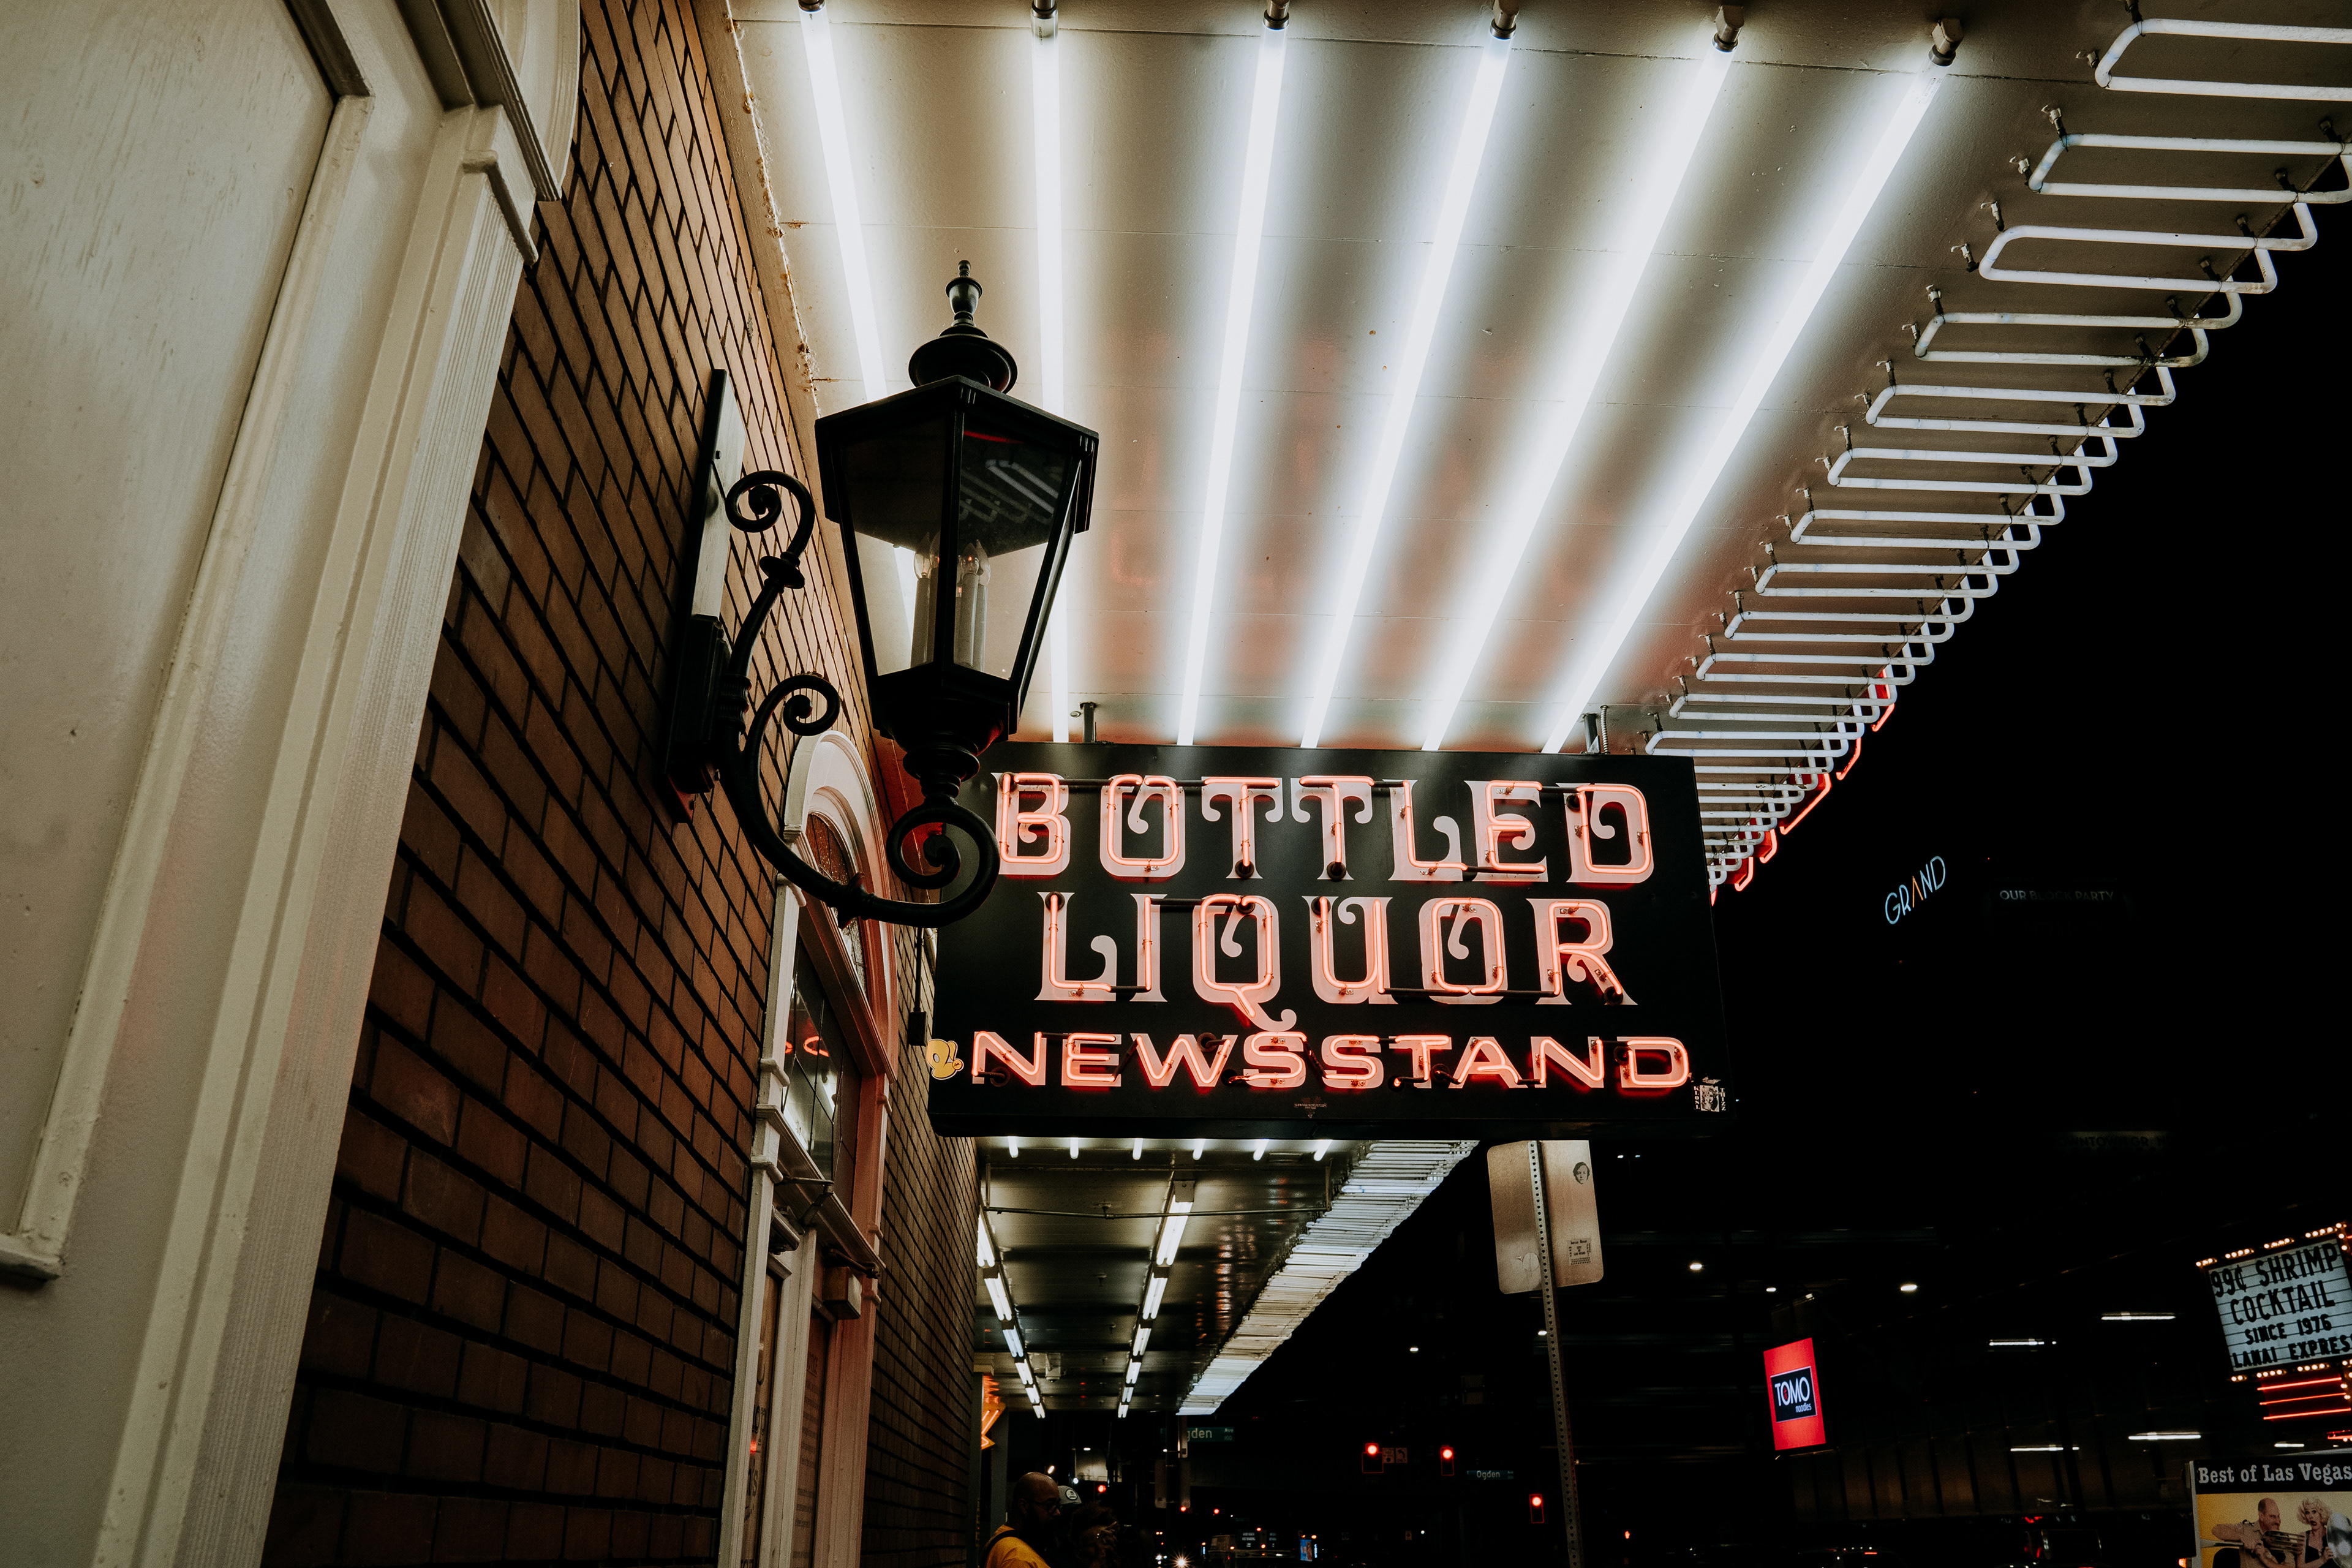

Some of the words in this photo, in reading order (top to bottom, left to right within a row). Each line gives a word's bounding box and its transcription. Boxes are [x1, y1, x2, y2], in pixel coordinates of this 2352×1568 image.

[991, 772, 1655, 883] BOTTLED
[1884, 855, 1947, 925] GRAND
[1999, 889, 2027, 902] OUR
[2029, 889, 2073, 902] BLOCK
[2075, 889, 2115, 902] PARTY
[1034, 892, 1638, 1031] LIQUOR
[971, 1031, 1689, 1089] NEWSSTAND
[2255, 1243, 2338, 1287] SHRIMP
[2230, 1280, 2335, 1325] COCKTAIL
[2244, 1322, 2288, 1346] SINCE
[2296, 1313, 2332, 1336] 1976
[2232, 1346, 2278, 1368] LANAI
[1774, 1376, 1811, 1407] TOMO
[1795, 1403, 1812, 1412] noodles
[1476, 1470, 1501, 1480] Ogden
[2198, 1467, 2234, 1483] Best
[2241, 1464, 2257, 1482] of
[2263, 1464, 2294, 1482] Las
[2298, 1463, 2352, 1485] Vegas
